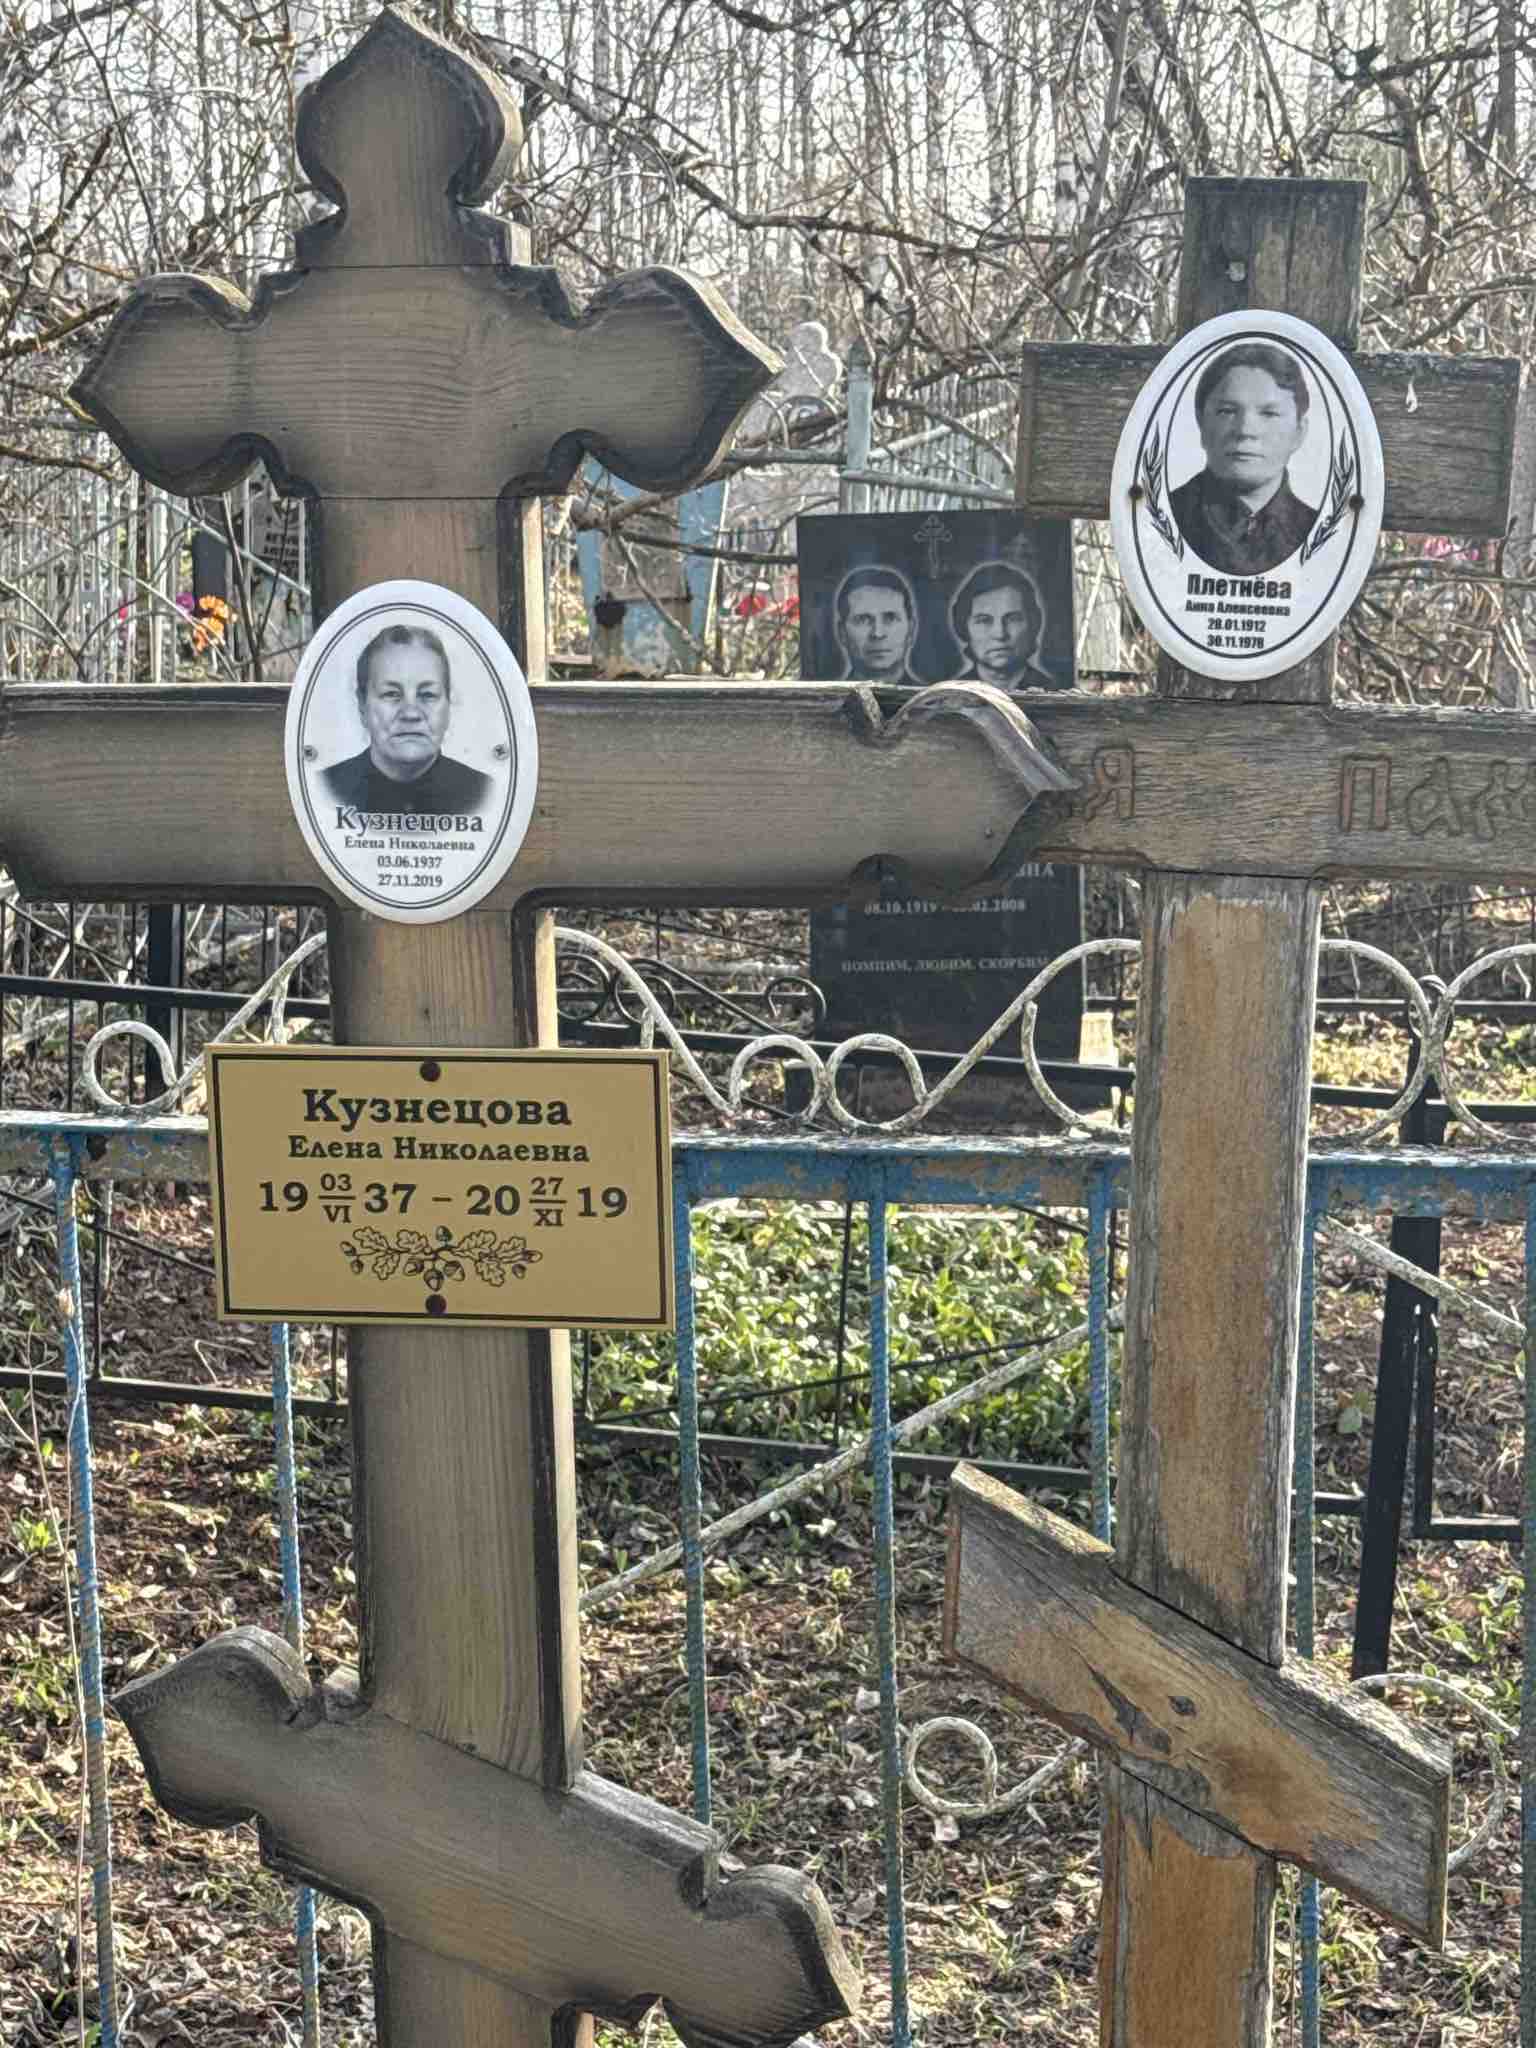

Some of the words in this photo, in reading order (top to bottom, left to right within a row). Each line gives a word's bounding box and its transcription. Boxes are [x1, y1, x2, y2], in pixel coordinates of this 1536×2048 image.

[1187, 573, 1292, 599] Плетнёва
[1185, 600, 1215, 612] Анна
[1217, 601, 1290, 616] Алексеевна
[336, 804, 483, 836] Кузнецова
[344, 836, 385, 850] Елена
[389, 837, 475, 851] Николаевна
[377, 855, 442, 869] 03.06.1937
[377, 874, 443, 887] 27.11.2019
[302, 1088, 572, 1132] Кузнецова
[288, 1135, 382, 1160] Елена
[394, 1136, 590, 1163] Николаевна
[320, 1174, 353, 1192] 03
[530, 1177, 564, 1196] 27
[259, 1181, 309, 1212] 19
[364, 1183, 418, 1214] 37
[466, 1185, 521, 1217] 20
[577, 1186, 628, 1218] 19
[323, 1205, 353, 1224] VI
[534, 1208, 564, 1227] XI
